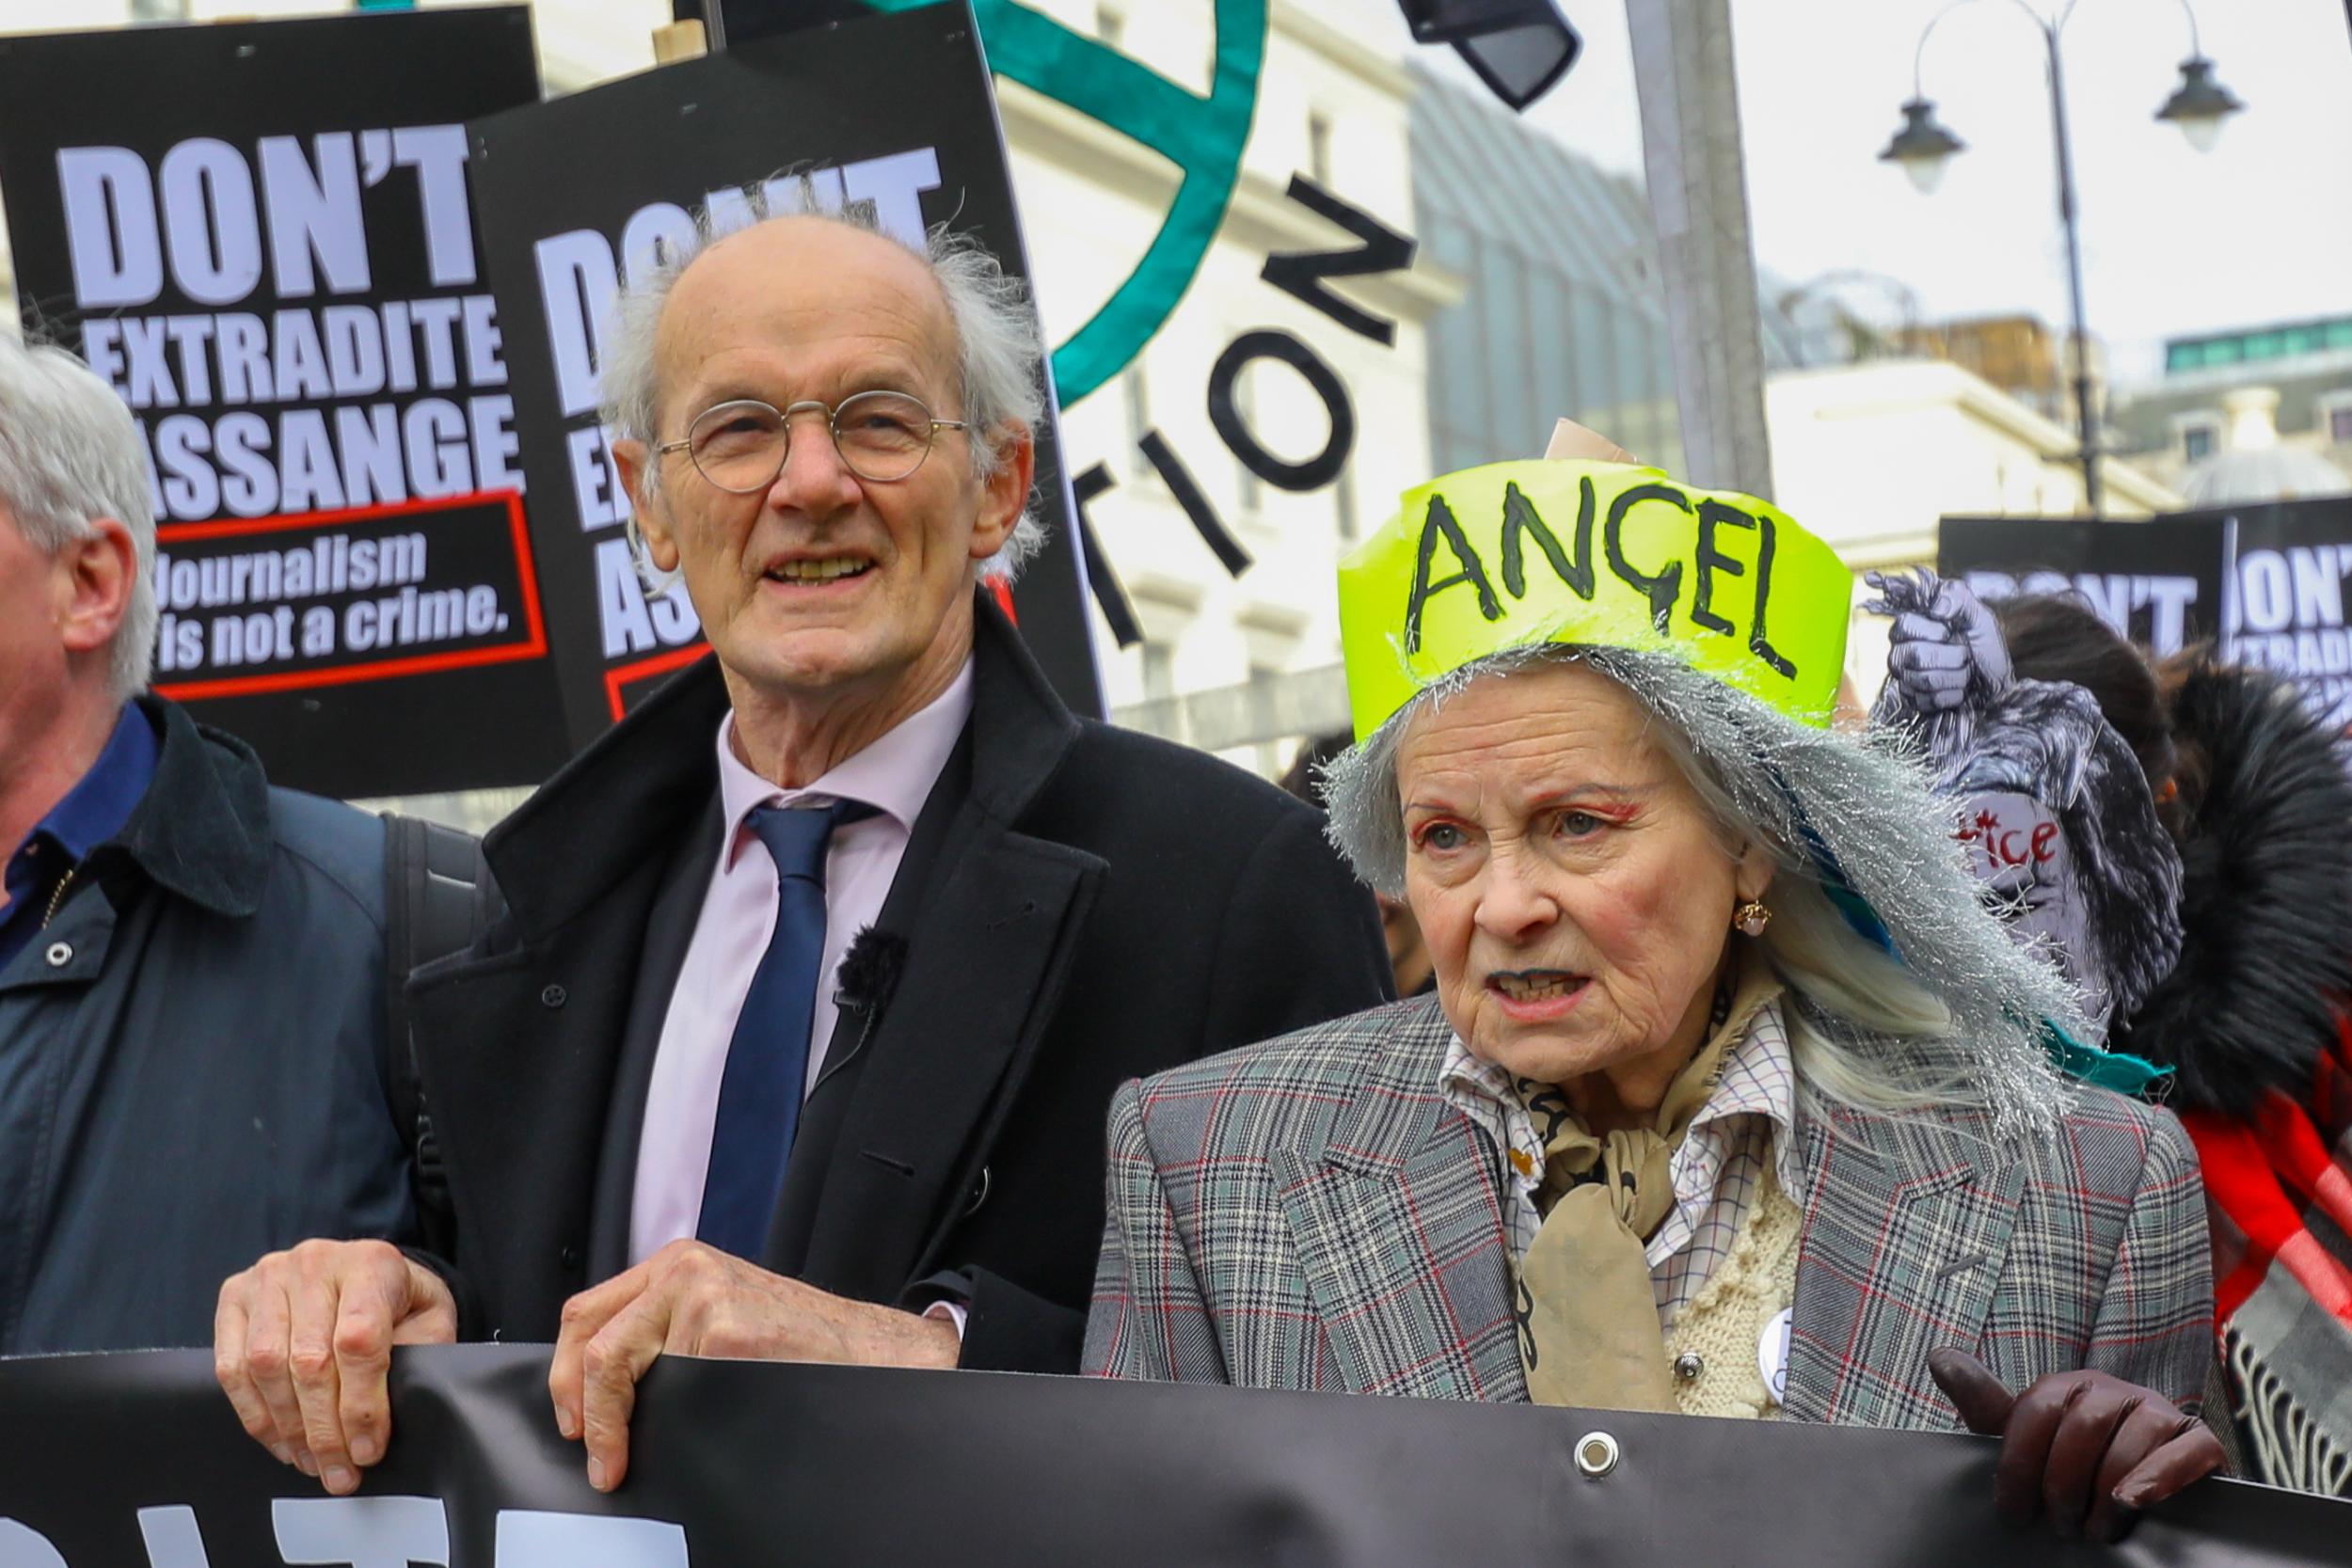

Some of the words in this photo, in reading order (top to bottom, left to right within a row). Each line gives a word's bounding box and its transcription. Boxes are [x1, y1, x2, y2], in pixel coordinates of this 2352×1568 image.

[56, 123, 477, 309] DON'T
[81, 294, 509, 408] EXTRADITE
[158, 613, 204, 673] is
[210, 605, 294, 668] not
[301, 606, 336, 658] a
[342, 583, 508, 652] crime.
[1405, 475, 1798, 682] ANGEL
